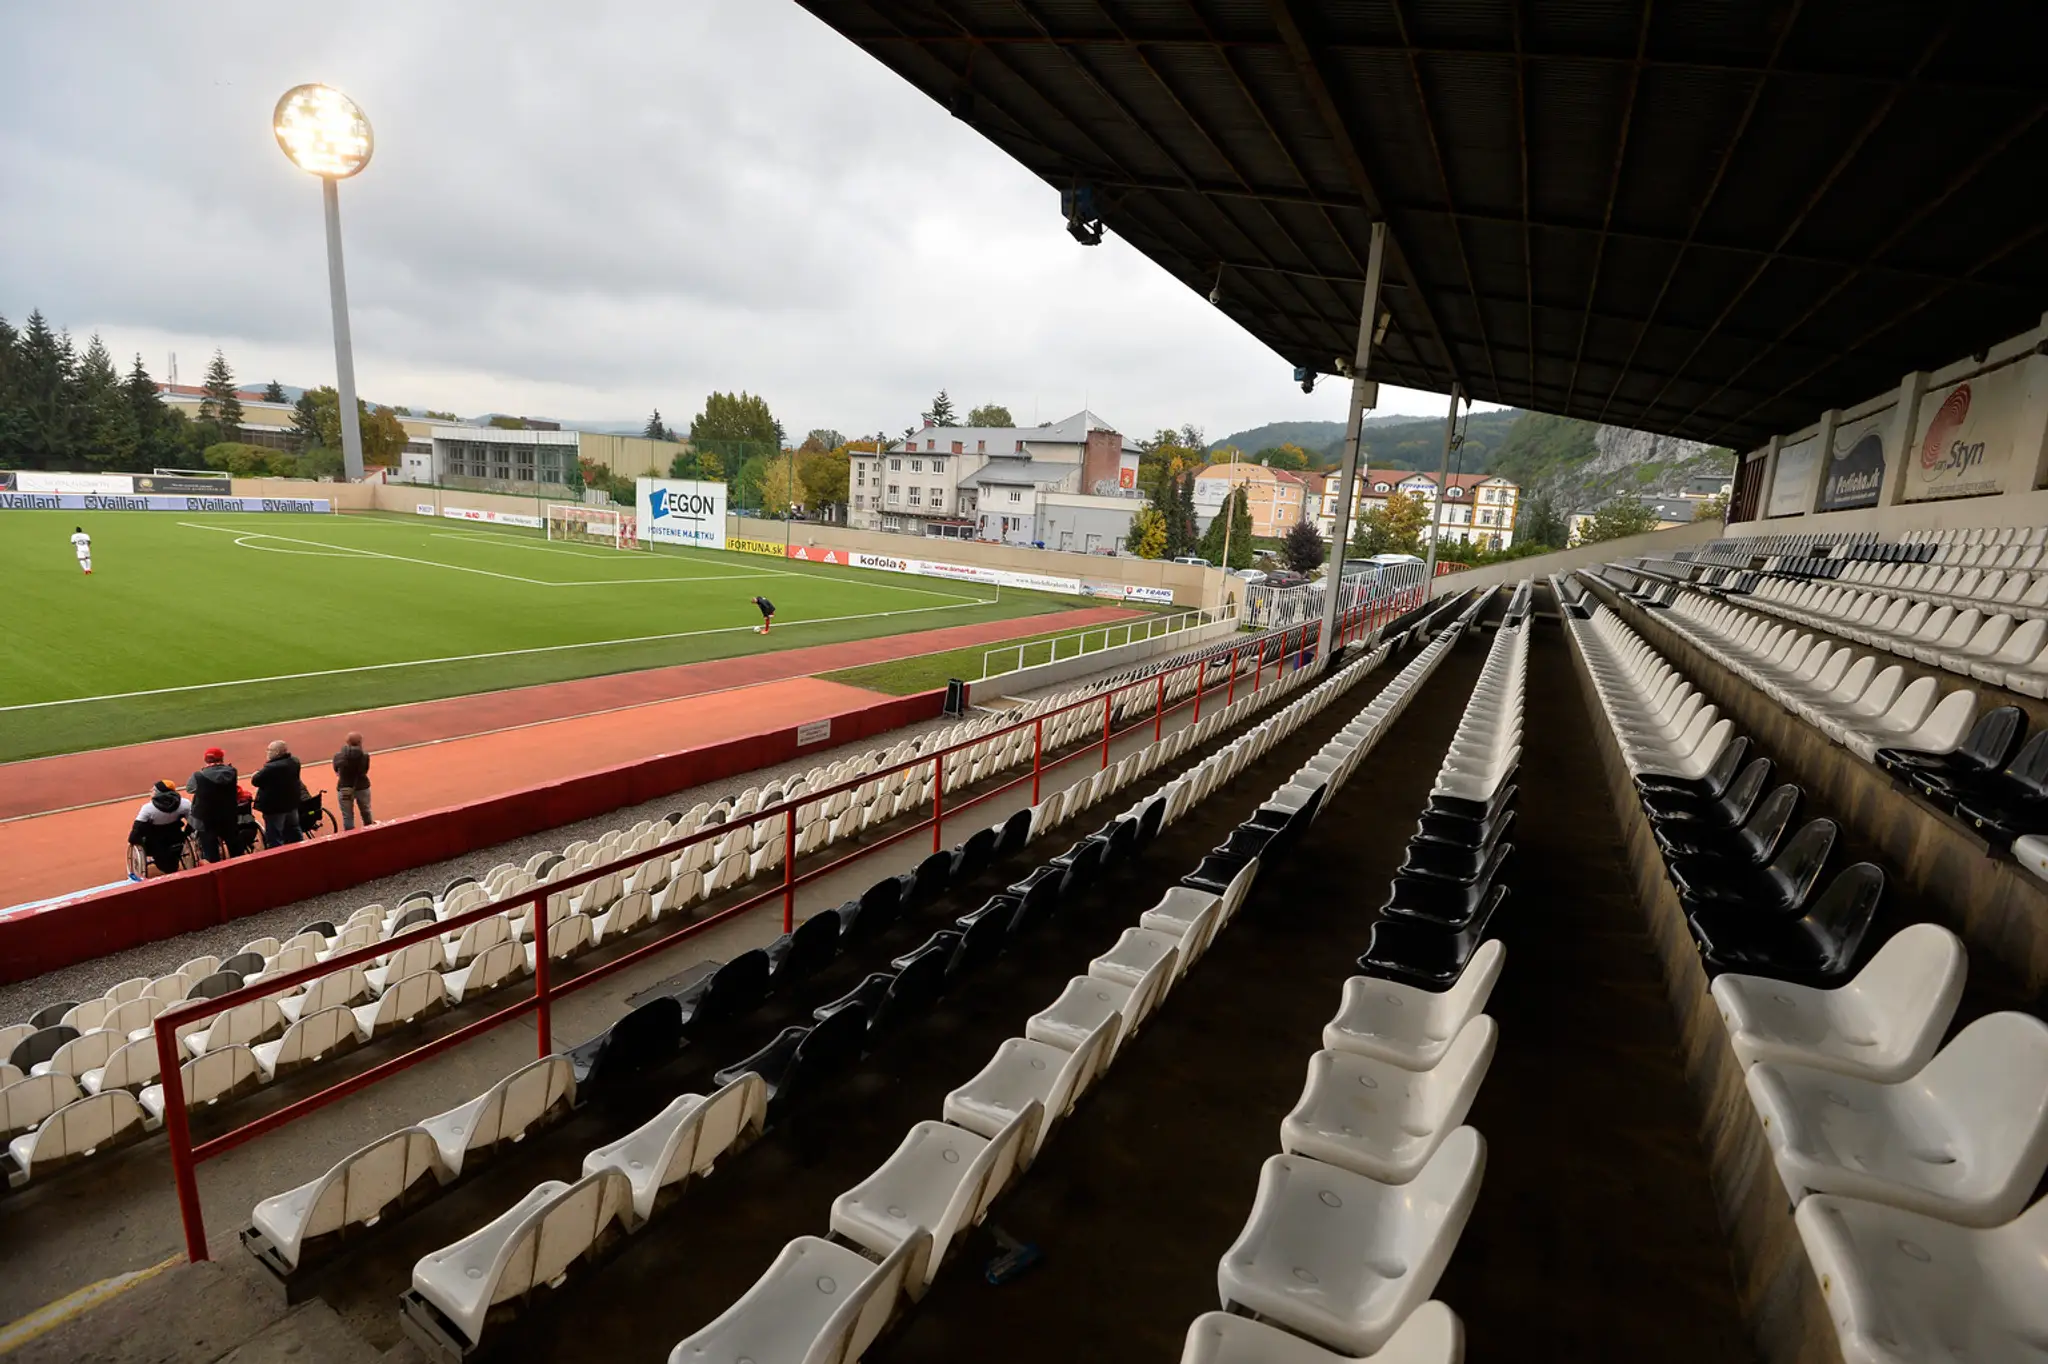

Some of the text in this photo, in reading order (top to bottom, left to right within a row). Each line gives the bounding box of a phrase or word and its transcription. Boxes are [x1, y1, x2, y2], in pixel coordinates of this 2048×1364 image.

[3, 494, 61, 508] Vaillant
[98, 495, 150, 510] Vaillant
[198, 498, 244, 511] Vaillant
[273, 500, 314, 512] Vaillant
[660, 493, 715, 515] AEGON
[683, 529, 715, 541] MAJETKU
[860, 554, 897, 569] kofola
